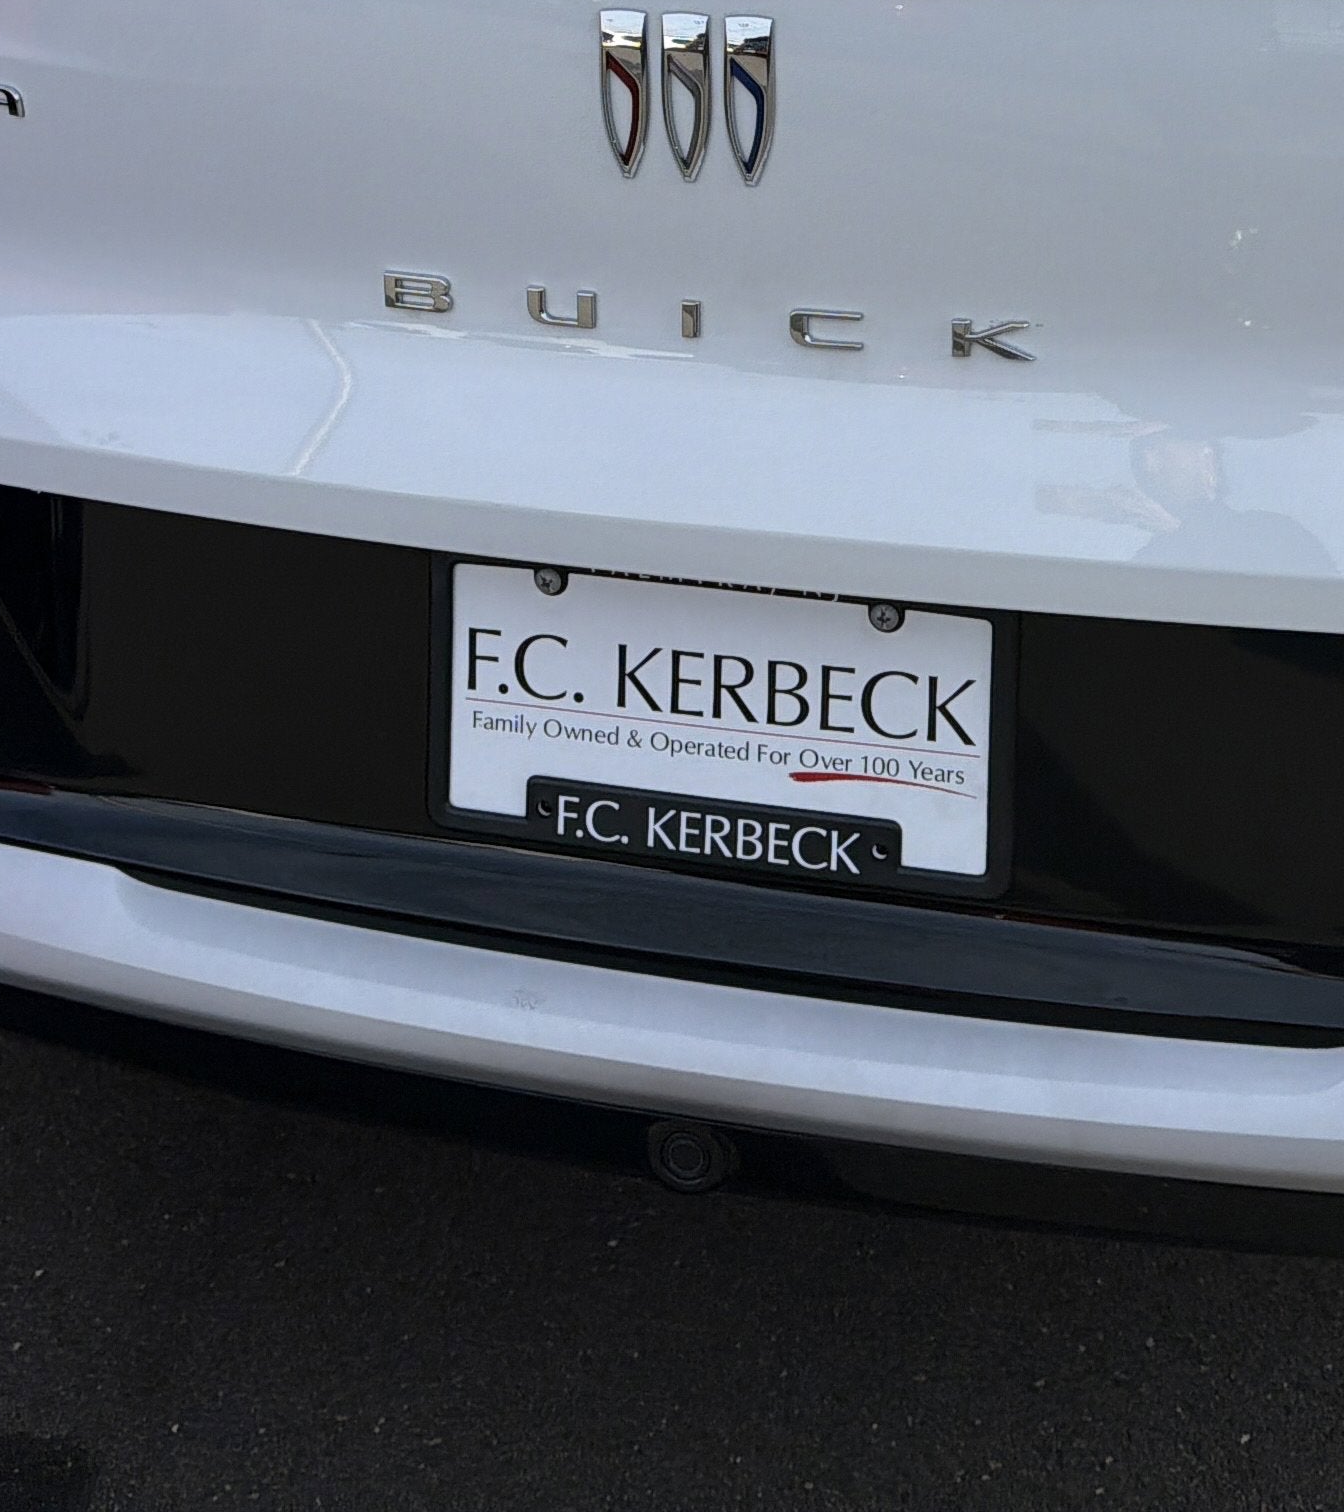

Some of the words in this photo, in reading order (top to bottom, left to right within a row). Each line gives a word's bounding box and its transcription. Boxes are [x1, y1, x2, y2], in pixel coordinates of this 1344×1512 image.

[383, 269, 1037, 361] BUICK
[466, 627, 585, 704] F.C.
[616, 643, 977, 747] KERBECK
[472, 710, 538, 740] Family
[543, 718, 620, 747] Owned
[626, 729, 643, 749] &
[650, 731, 751, 762] Operated
[756, 744, 792, 766] For
[798, 748, 853, 773] Over
[861, 754, 900, 778] 100
[908, 759, 966, 786] Years
[556, 794, 630, 845] F.C.
[646, 806, 861, 875] KERBECK
